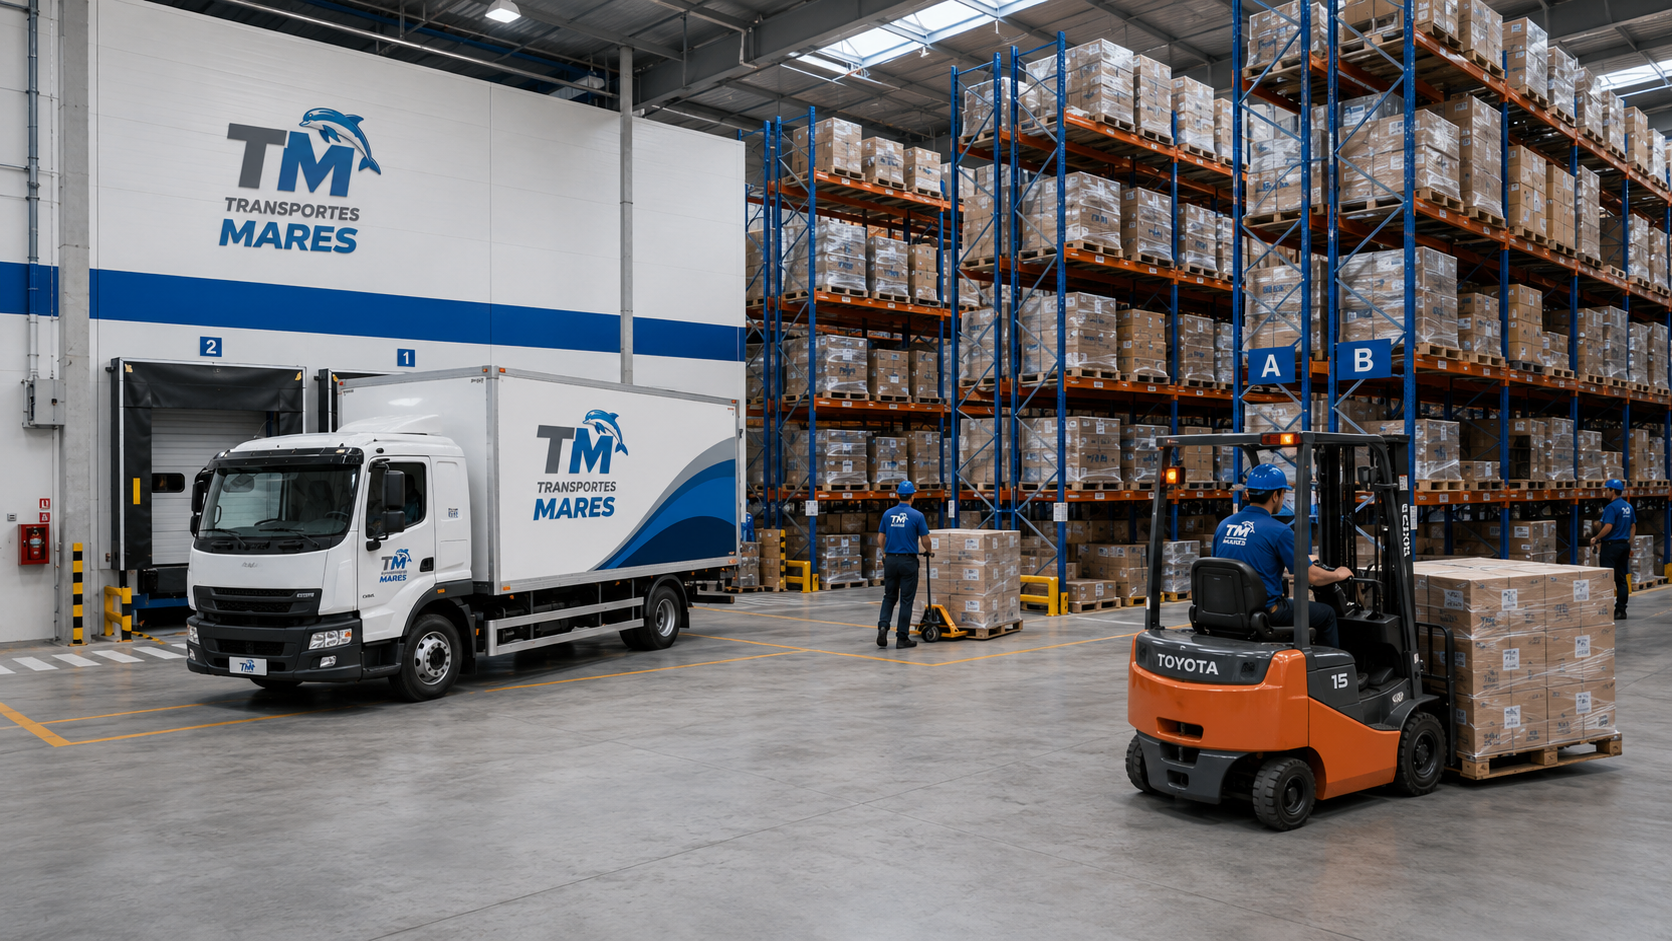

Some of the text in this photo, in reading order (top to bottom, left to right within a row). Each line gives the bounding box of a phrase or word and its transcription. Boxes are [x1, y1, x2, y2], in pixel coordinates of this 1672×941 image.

[226, 122, 355, 197] TM
[225, 197, 360, 222] TRANSPORTES
[218, 218, 359, 254] MARES
[205, 339, 217, 355] 2
[402, 351, 410, 365] 1
[1260, 353, 1282, 378] A
[1353, 347, 1374, 373] B
[536, 424, 614, 474] TM
[537, 481, 617, 493] TRANSPORTES
[533, 496, 616, 521] MARES
[890, 515, 905, 524] TM
[1226, 524, 1251, 538] TM
[381, 555, 407, 571] TM
[379, 574, 407, 583] MARES
[1157, 653, 1219, 675] TOYOTA
[1331, 672, 1348, 690] 15
